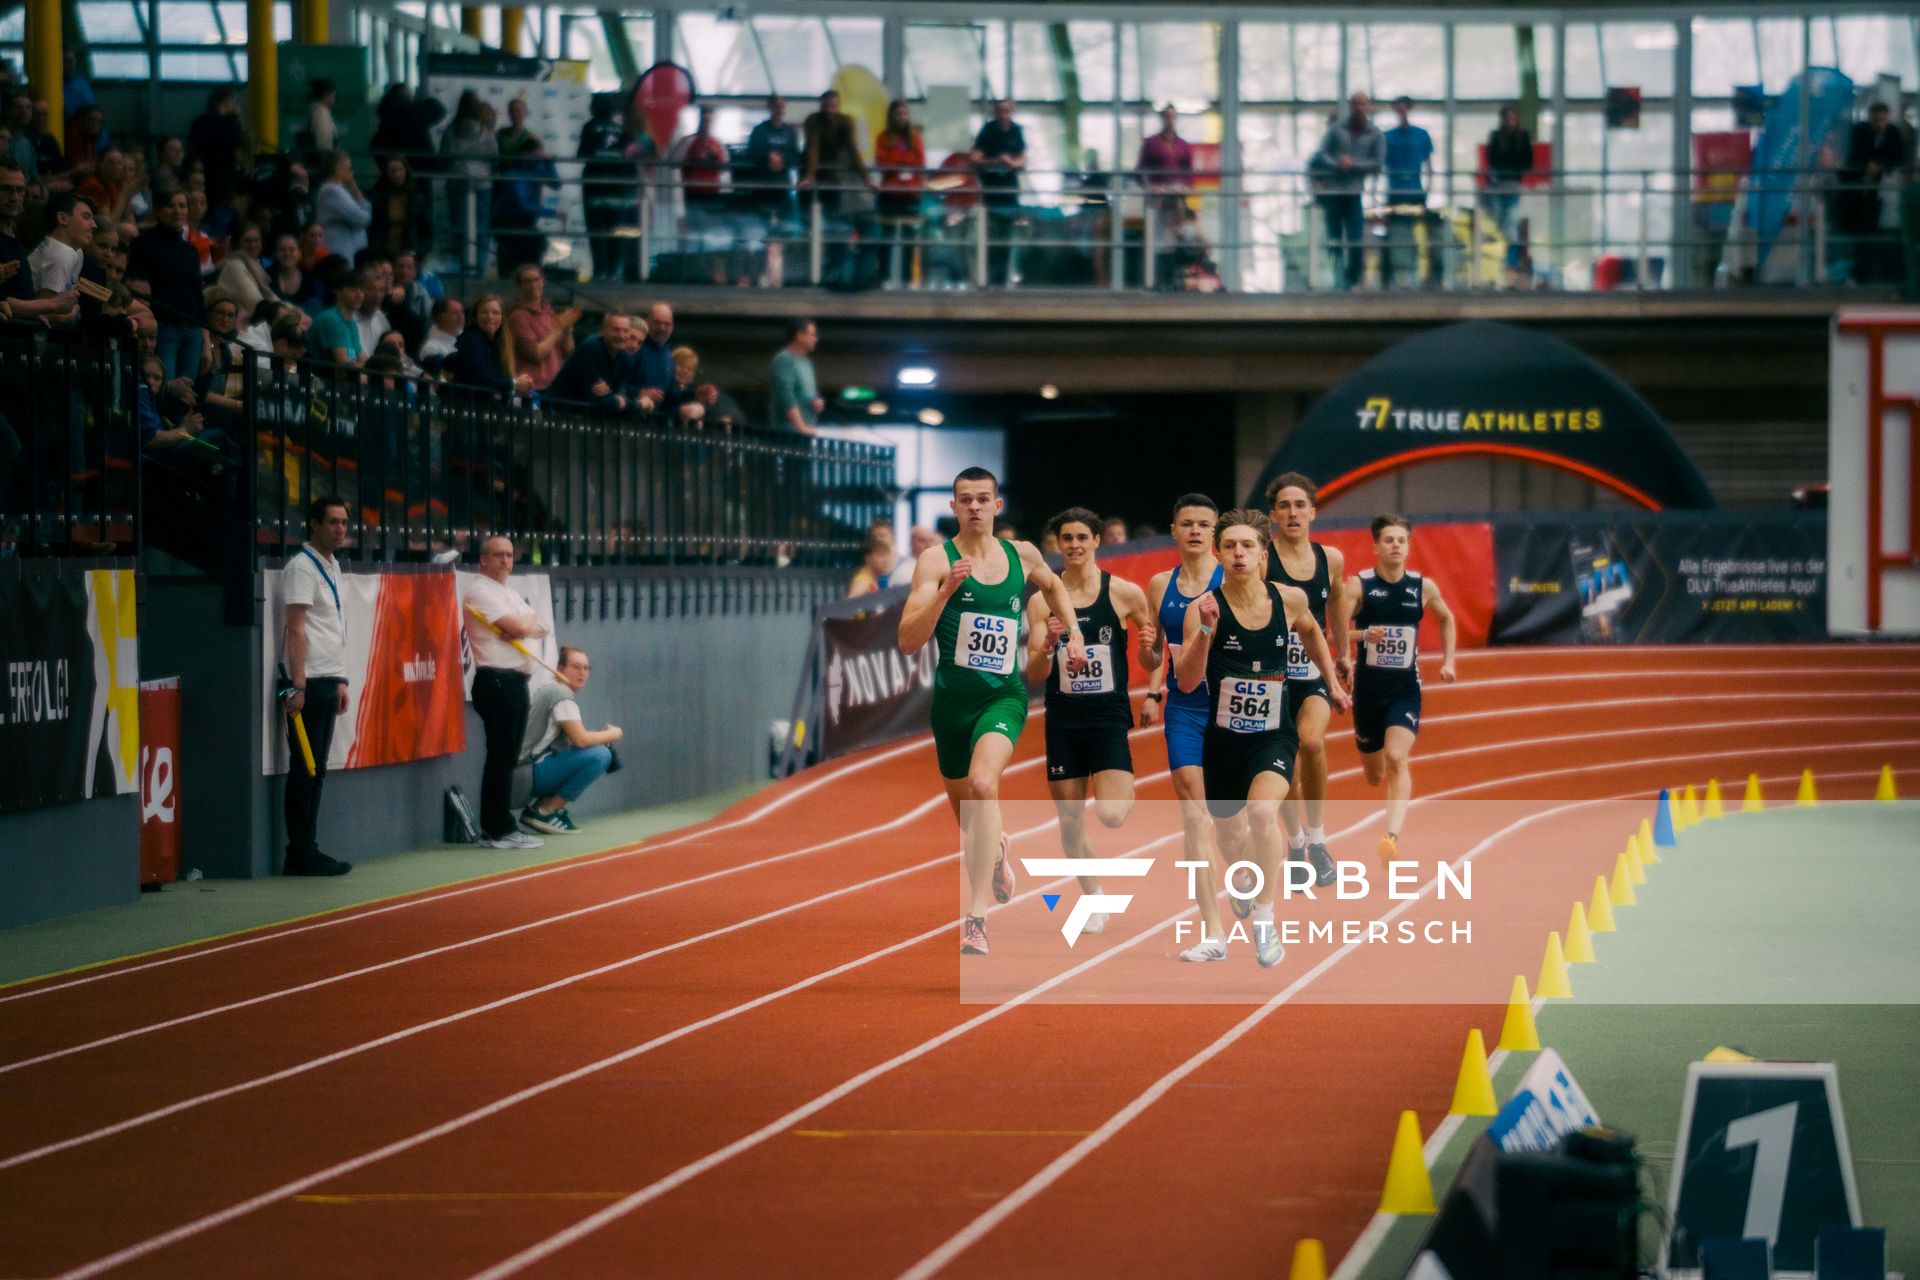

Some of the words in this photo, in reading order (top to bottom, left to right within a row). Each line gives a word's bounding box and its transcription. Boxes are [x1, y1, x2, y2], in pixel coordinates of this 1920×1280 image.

[1678, 559, 1699, 573] Alle
[1702, 559, 1765, 577] Ergebnisse
[1768, 559, 1788, 573] live
[1790, 559, 1802, 573] in
[1805, 559, 1824, 573] der
[1714, 578, 1786, 593] TrueAthletes
[1789, 579, 1817, 596] App!
[973, 616, 1005, 632] GLS
[967, 631, 1009, 656] 303
[1375, 639, 1407, 655] 659
[9, 659, 69, 724] ERFOLG!
[1234, 682, 1267, 696] GLS
[1229, 695, 1271, 718] 564
[1724, 1101, 1799, 1248] 1
